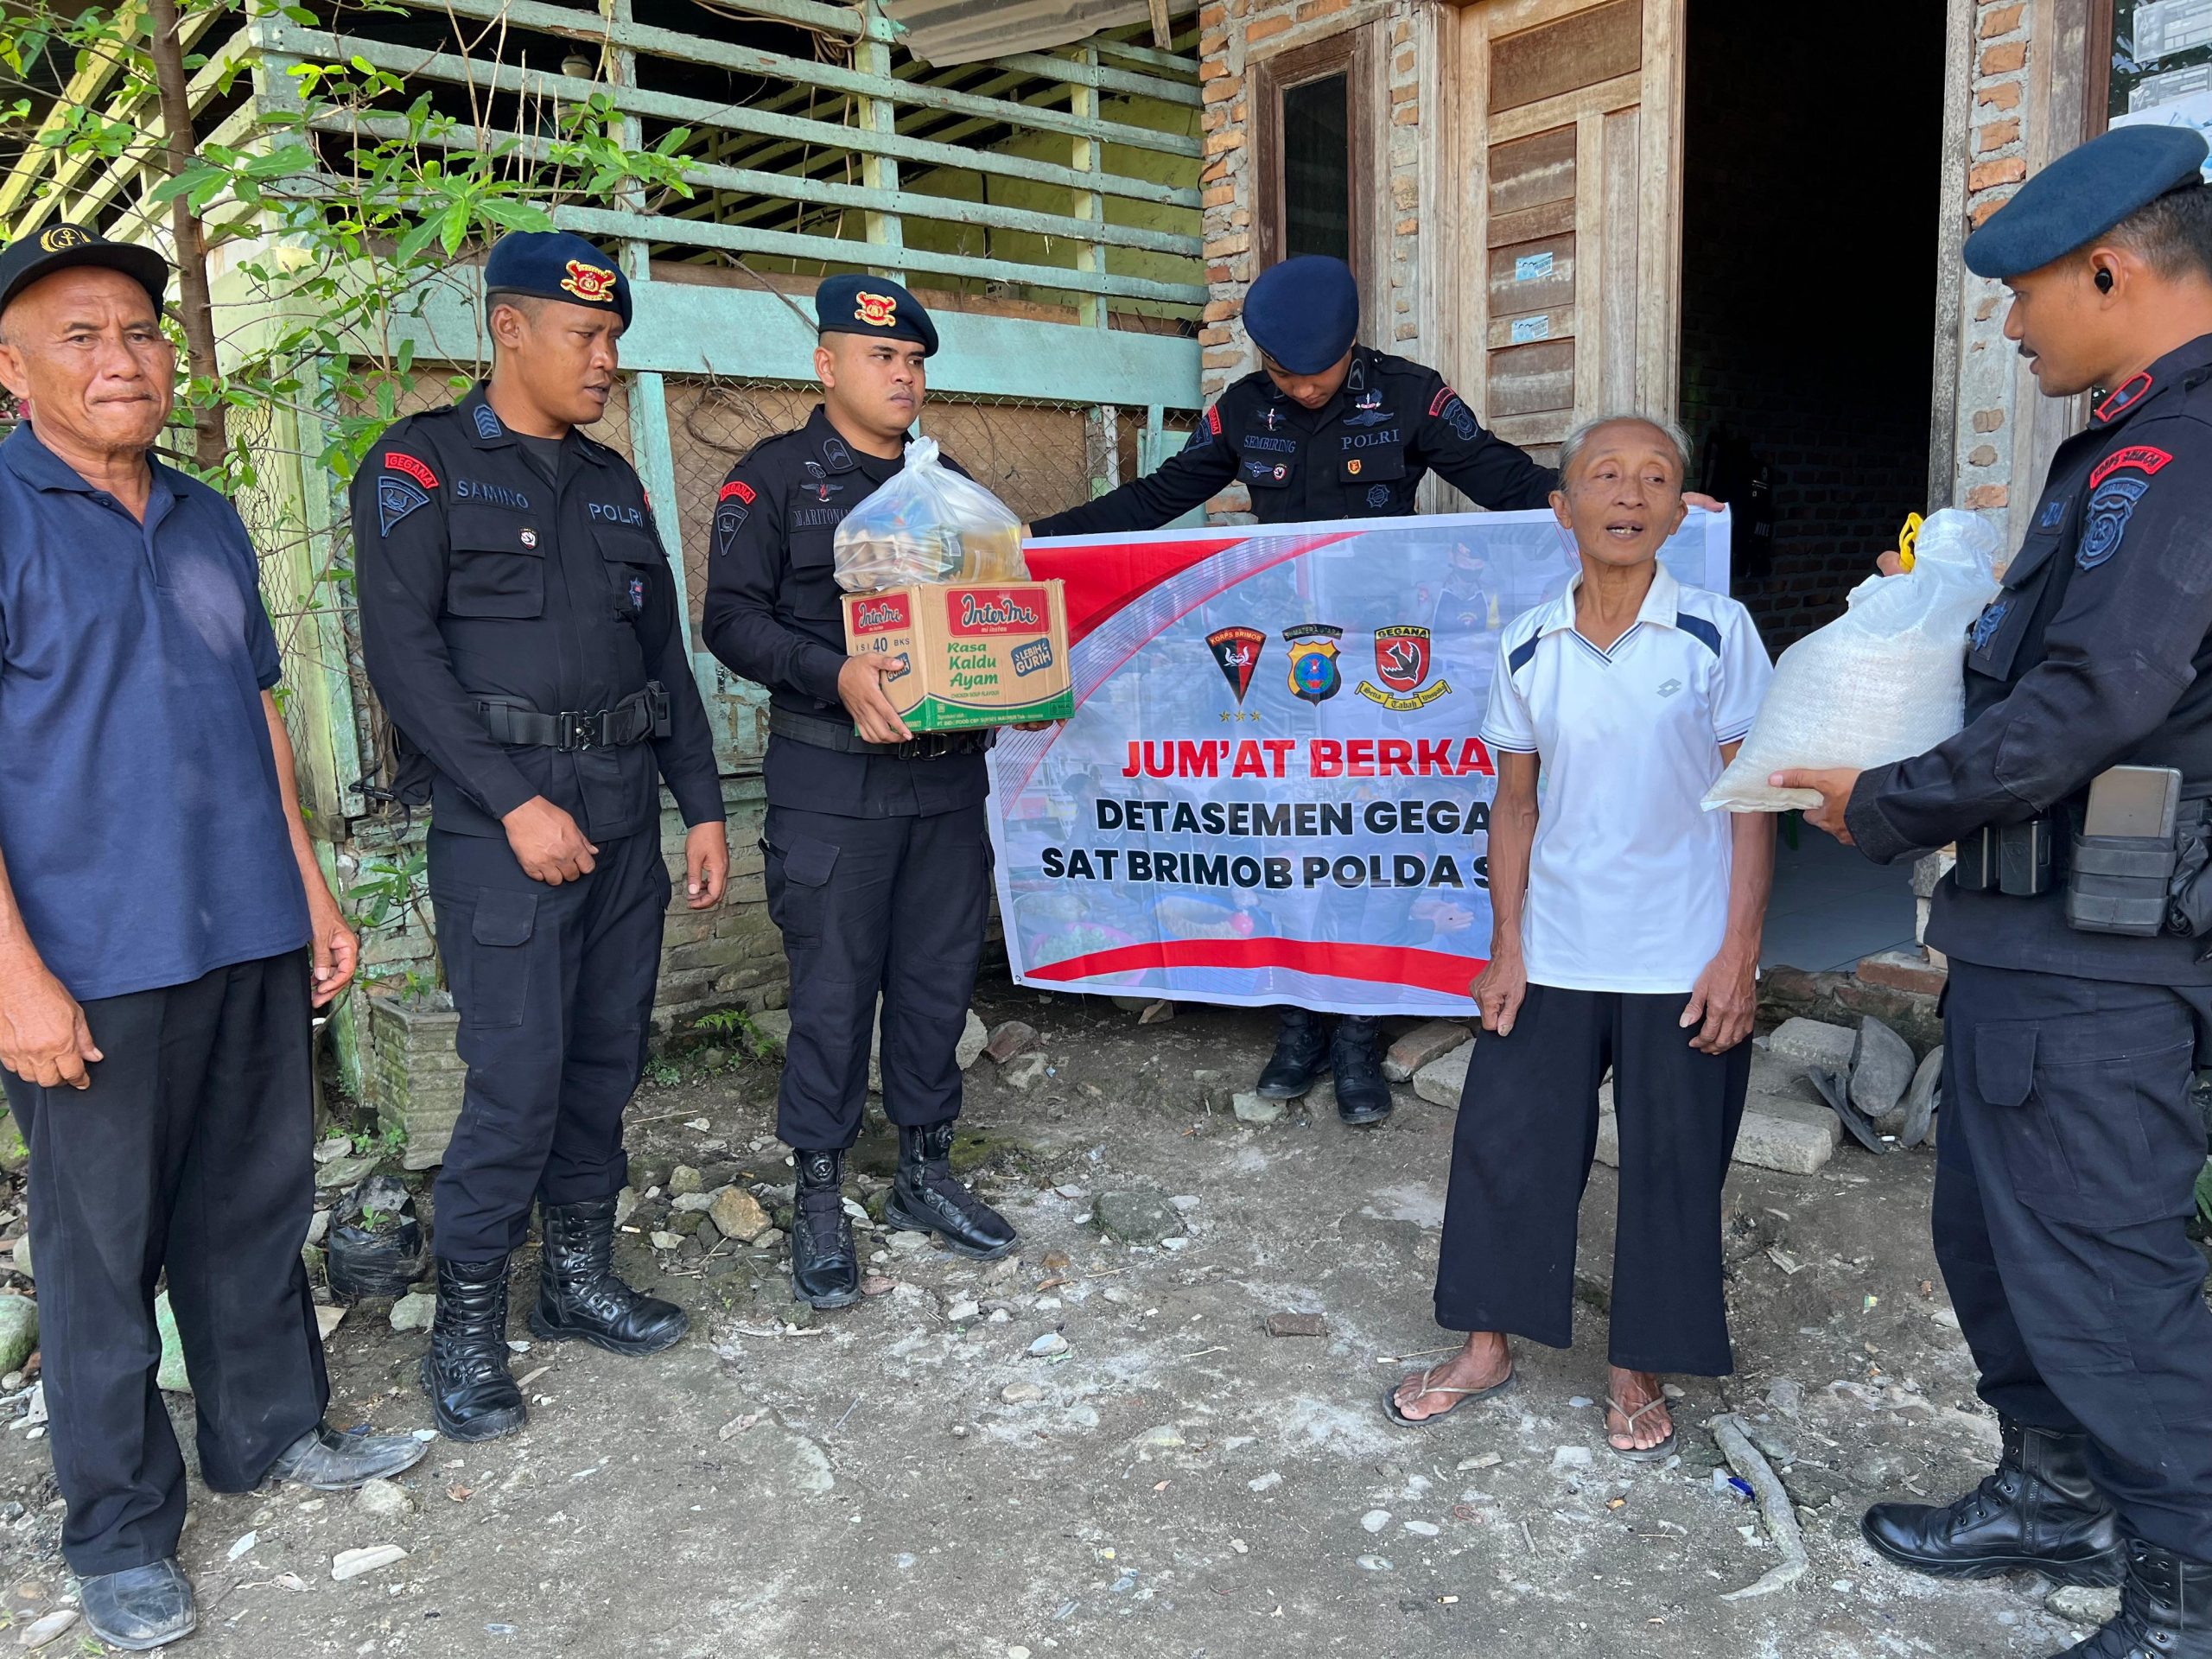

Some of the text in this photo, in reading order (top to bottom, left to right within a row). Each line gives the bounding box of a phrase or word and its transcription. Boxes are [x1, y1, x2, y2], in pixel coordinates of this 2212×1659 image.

[1244, 435, 1296, 453] SEMBIRING
[1341, 429, 1400, 450] POLRI
[390, 456, 433, 484] GEGANA
[457, 480, 529, 509] SAMINO
[588, 503, 644, 528] POLRI
[1211, 632, 1262, 645] KORPS BRIMOB
[1378, 627, 1427, 638] GEGANA
[874, 637, 887, 652] 40
[893, 638, 910, 646] BKS
[947, 642, 987, 653] Rasa
[1020, 644, 1044, 661] LEBIH
[949, 654, 996, 670] Kaldu
[1016, 651, 1052, 673] GURIH
[950, 671, 998, 690] Ayam
[1391, 700, 1417, 709] Tabah
[1310, 737, 1496, 778] BERKA
[1096, 799, 1490, 836] DETASEMEN GEGA
[1042, 848, 1118, 880] SAT
[1127, 850, 1292, 889] BRIMOB
[1302, 855, 1464, 889] POLDA
